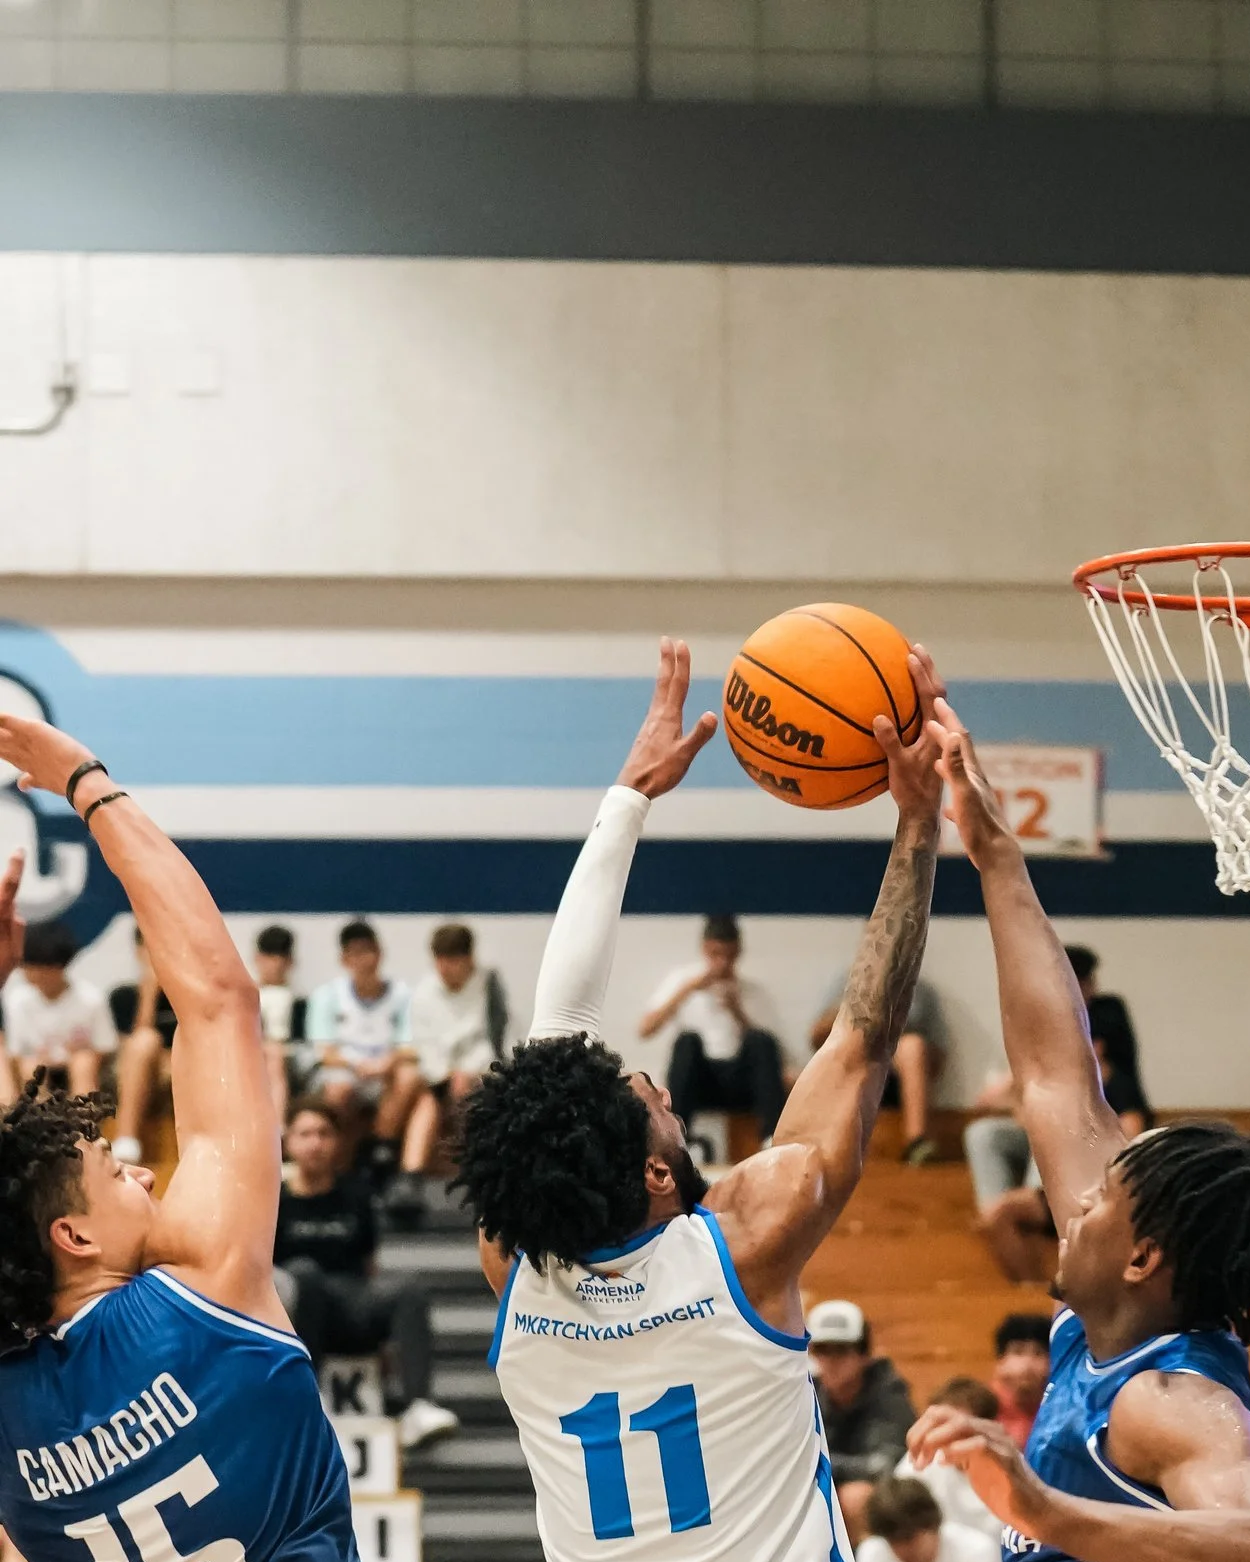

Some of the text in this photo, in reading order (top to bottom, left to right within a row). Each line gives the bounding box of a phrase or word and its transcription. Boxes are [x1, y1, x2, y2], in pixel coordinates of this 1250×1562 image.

[726, 667, 825, 758] Wilson
[575, 1281, 646, 1297] ARMENIA
[513, 1296, 716, 1341] MKRTCHYAN-SPIGHT
[331, 1370, 366, 1415] K
[16, 1371, 199, 1502] CAMACHO
[350, 1437, 368, 1479] J
[558, 1383, 712, 1541] 11
[376, 1517, 388, 1559] I
